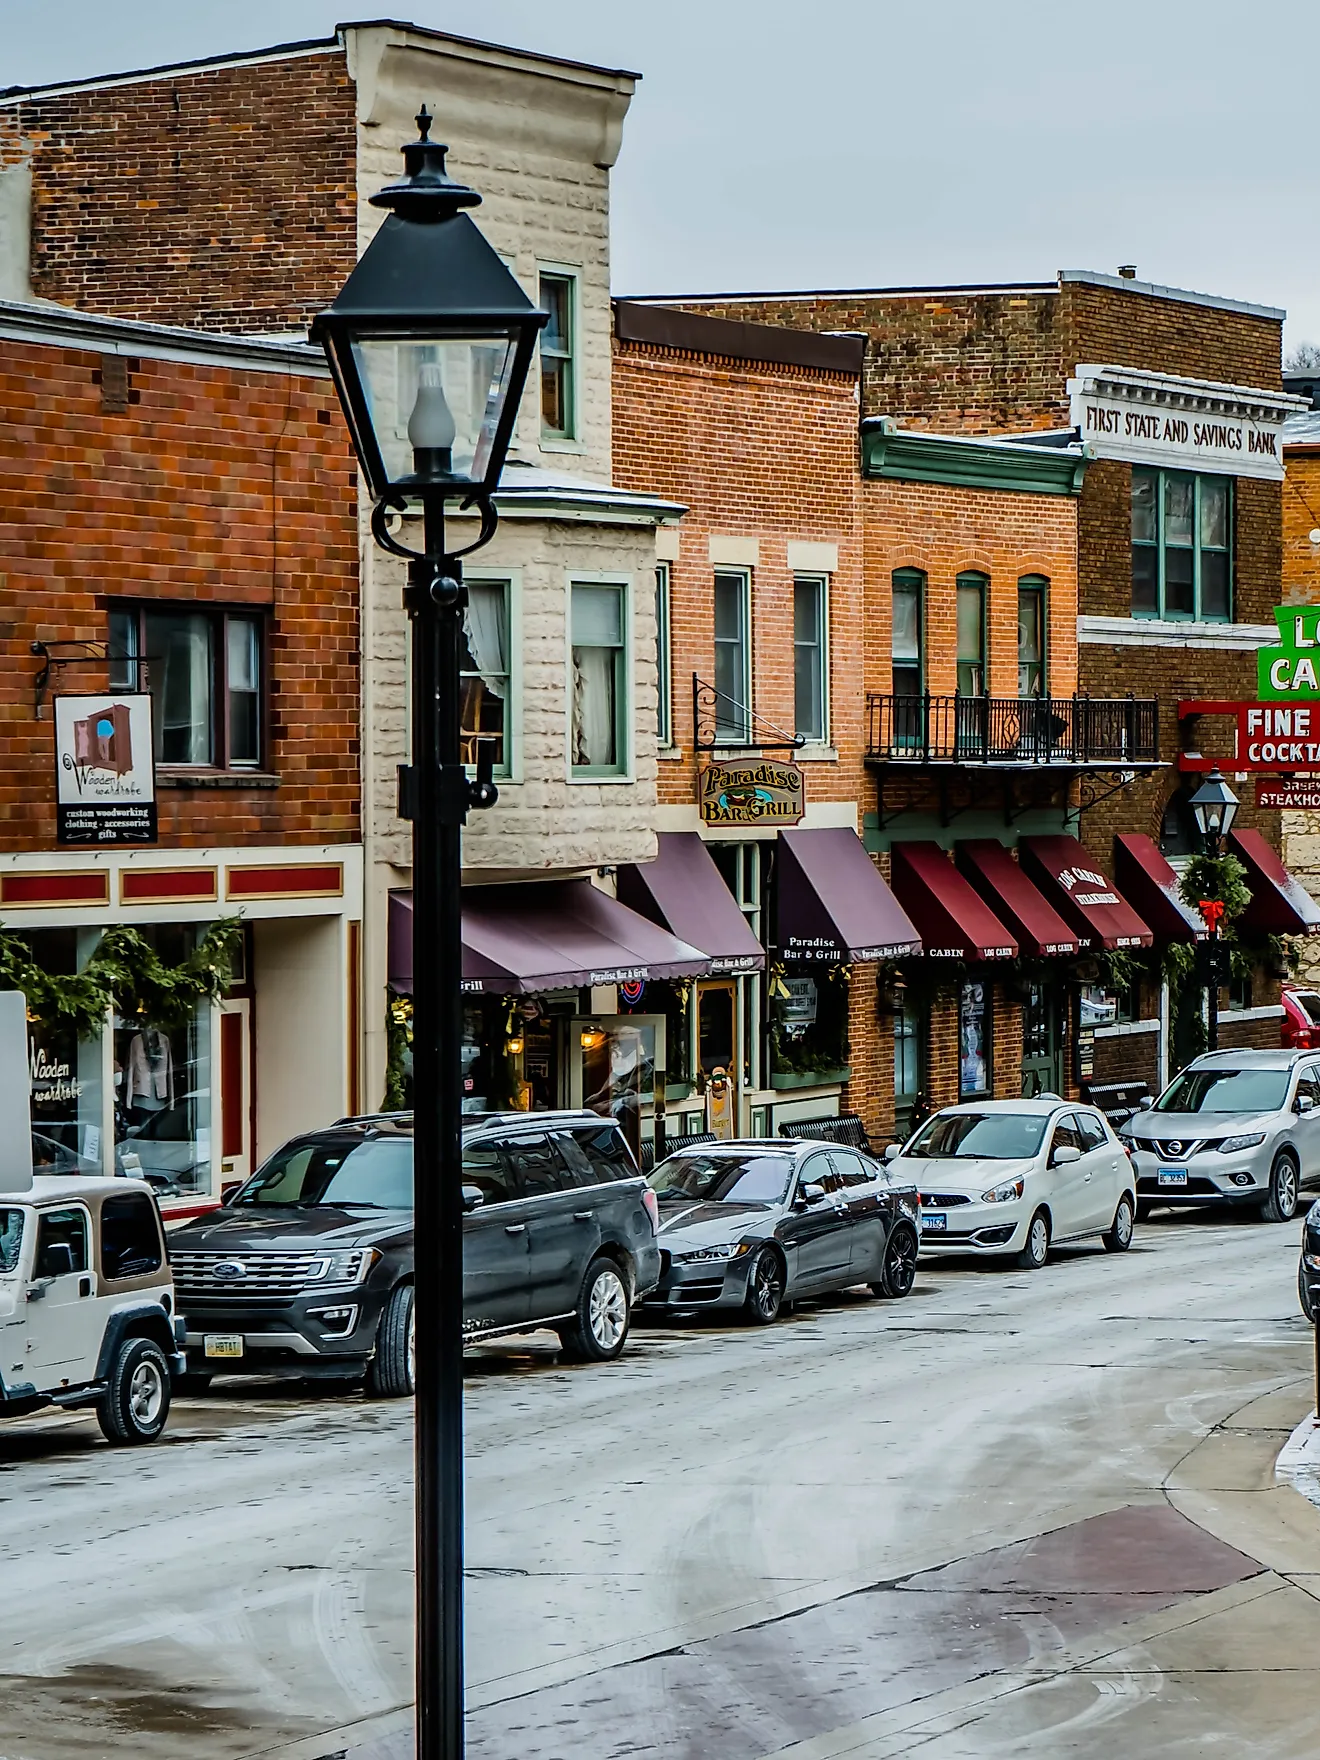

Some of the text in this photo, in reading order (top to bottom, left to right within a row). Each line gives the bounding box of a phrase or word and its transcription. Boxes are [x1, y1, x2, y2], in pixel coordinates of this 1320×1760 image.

[1086, 405, 1277, 456] FIRST STATE AND SAVINGS BANK
[1247, 709, 1311, 737] FINE
[62, 753, 116, 795] Wooden
[704, 764, 801, 797] Paradise
[96, 782, 142, 796] wardrobe
[66, 807, 149, 818] custom woodworking
[703, 800, 745, 822] BAR
[746, 796, 802, 820] GRILL
[65, 818, 98, 829] clothing
[104, 818, 150, 828] accessories
[98, 829, 117, 840] gifts
[1058, 866, 1108, 890] LOG CABIN
[789, 936, 835, 947] Paradise
[784, 949, 841, 960] Bar & Grill
[929, 949, 965, 957] CABIN
[590, 972, 616, 982] Paradise
[617, 969, 628, 979] Bar
[634, 967, 649, 977] Grill
[34, 1077, 83, 1101] wardrobe
